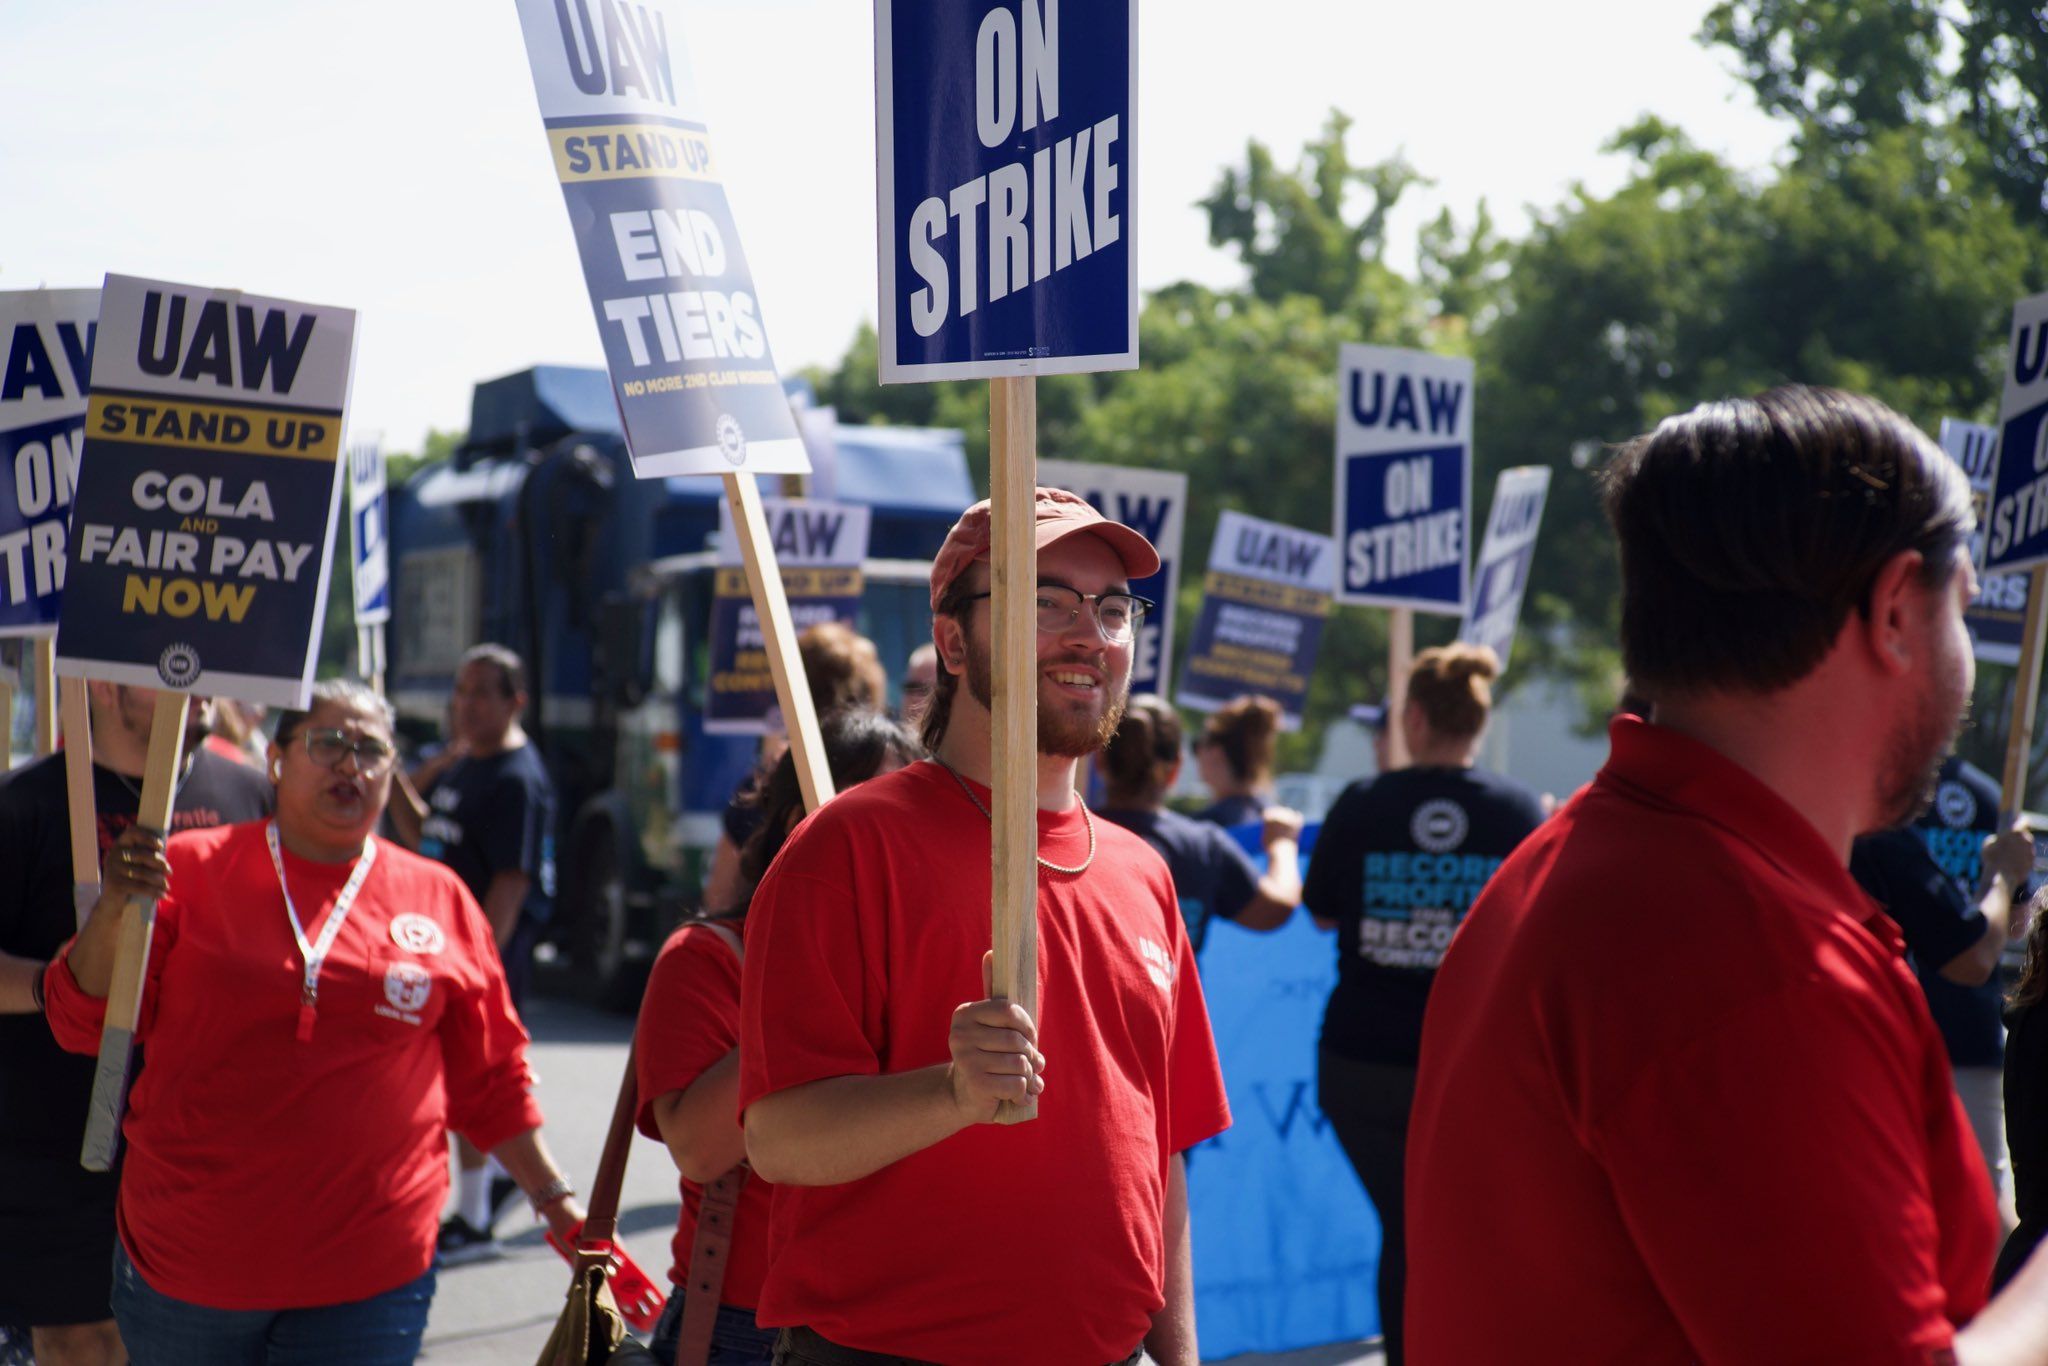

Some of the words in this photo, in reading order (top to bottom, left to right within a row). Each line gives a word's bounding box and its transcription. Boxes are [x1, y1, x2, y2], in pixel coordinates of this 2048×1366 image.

[555, 0, 677, 106] UAW
[976, 0, 1059, 148] ON
[564, 134, 680, 174] STAND
[682, 141, 710, 174] UP
[609, 209, 726, 282] END
[909, 113, 1120, 338] STRIKE
[138, 290, 317, 394] UAW
[603, 291, 765, 367] TIERS
[623, 381, 645, 397] NO
[646, 375, 683, 393] MORE
[1350, 369, 1464, 436] UAW
[100, 403, 251, 446] STAND
[266, 418, 325, 451] UP
[131, 470, 275, 521] COLA
[1383, 456, 1433, 519] ON
[80, 523, 200, 573] FAIR
[209, 536, 313, 582] PAY
[179, 517, 219, 534] AND
[765, 509, 844, 558] AW
[1236, 526, 1322, 578] UAW
[1348, 506, 1461, 588] STRIKE
[122, 575, 257, 624] NOW
